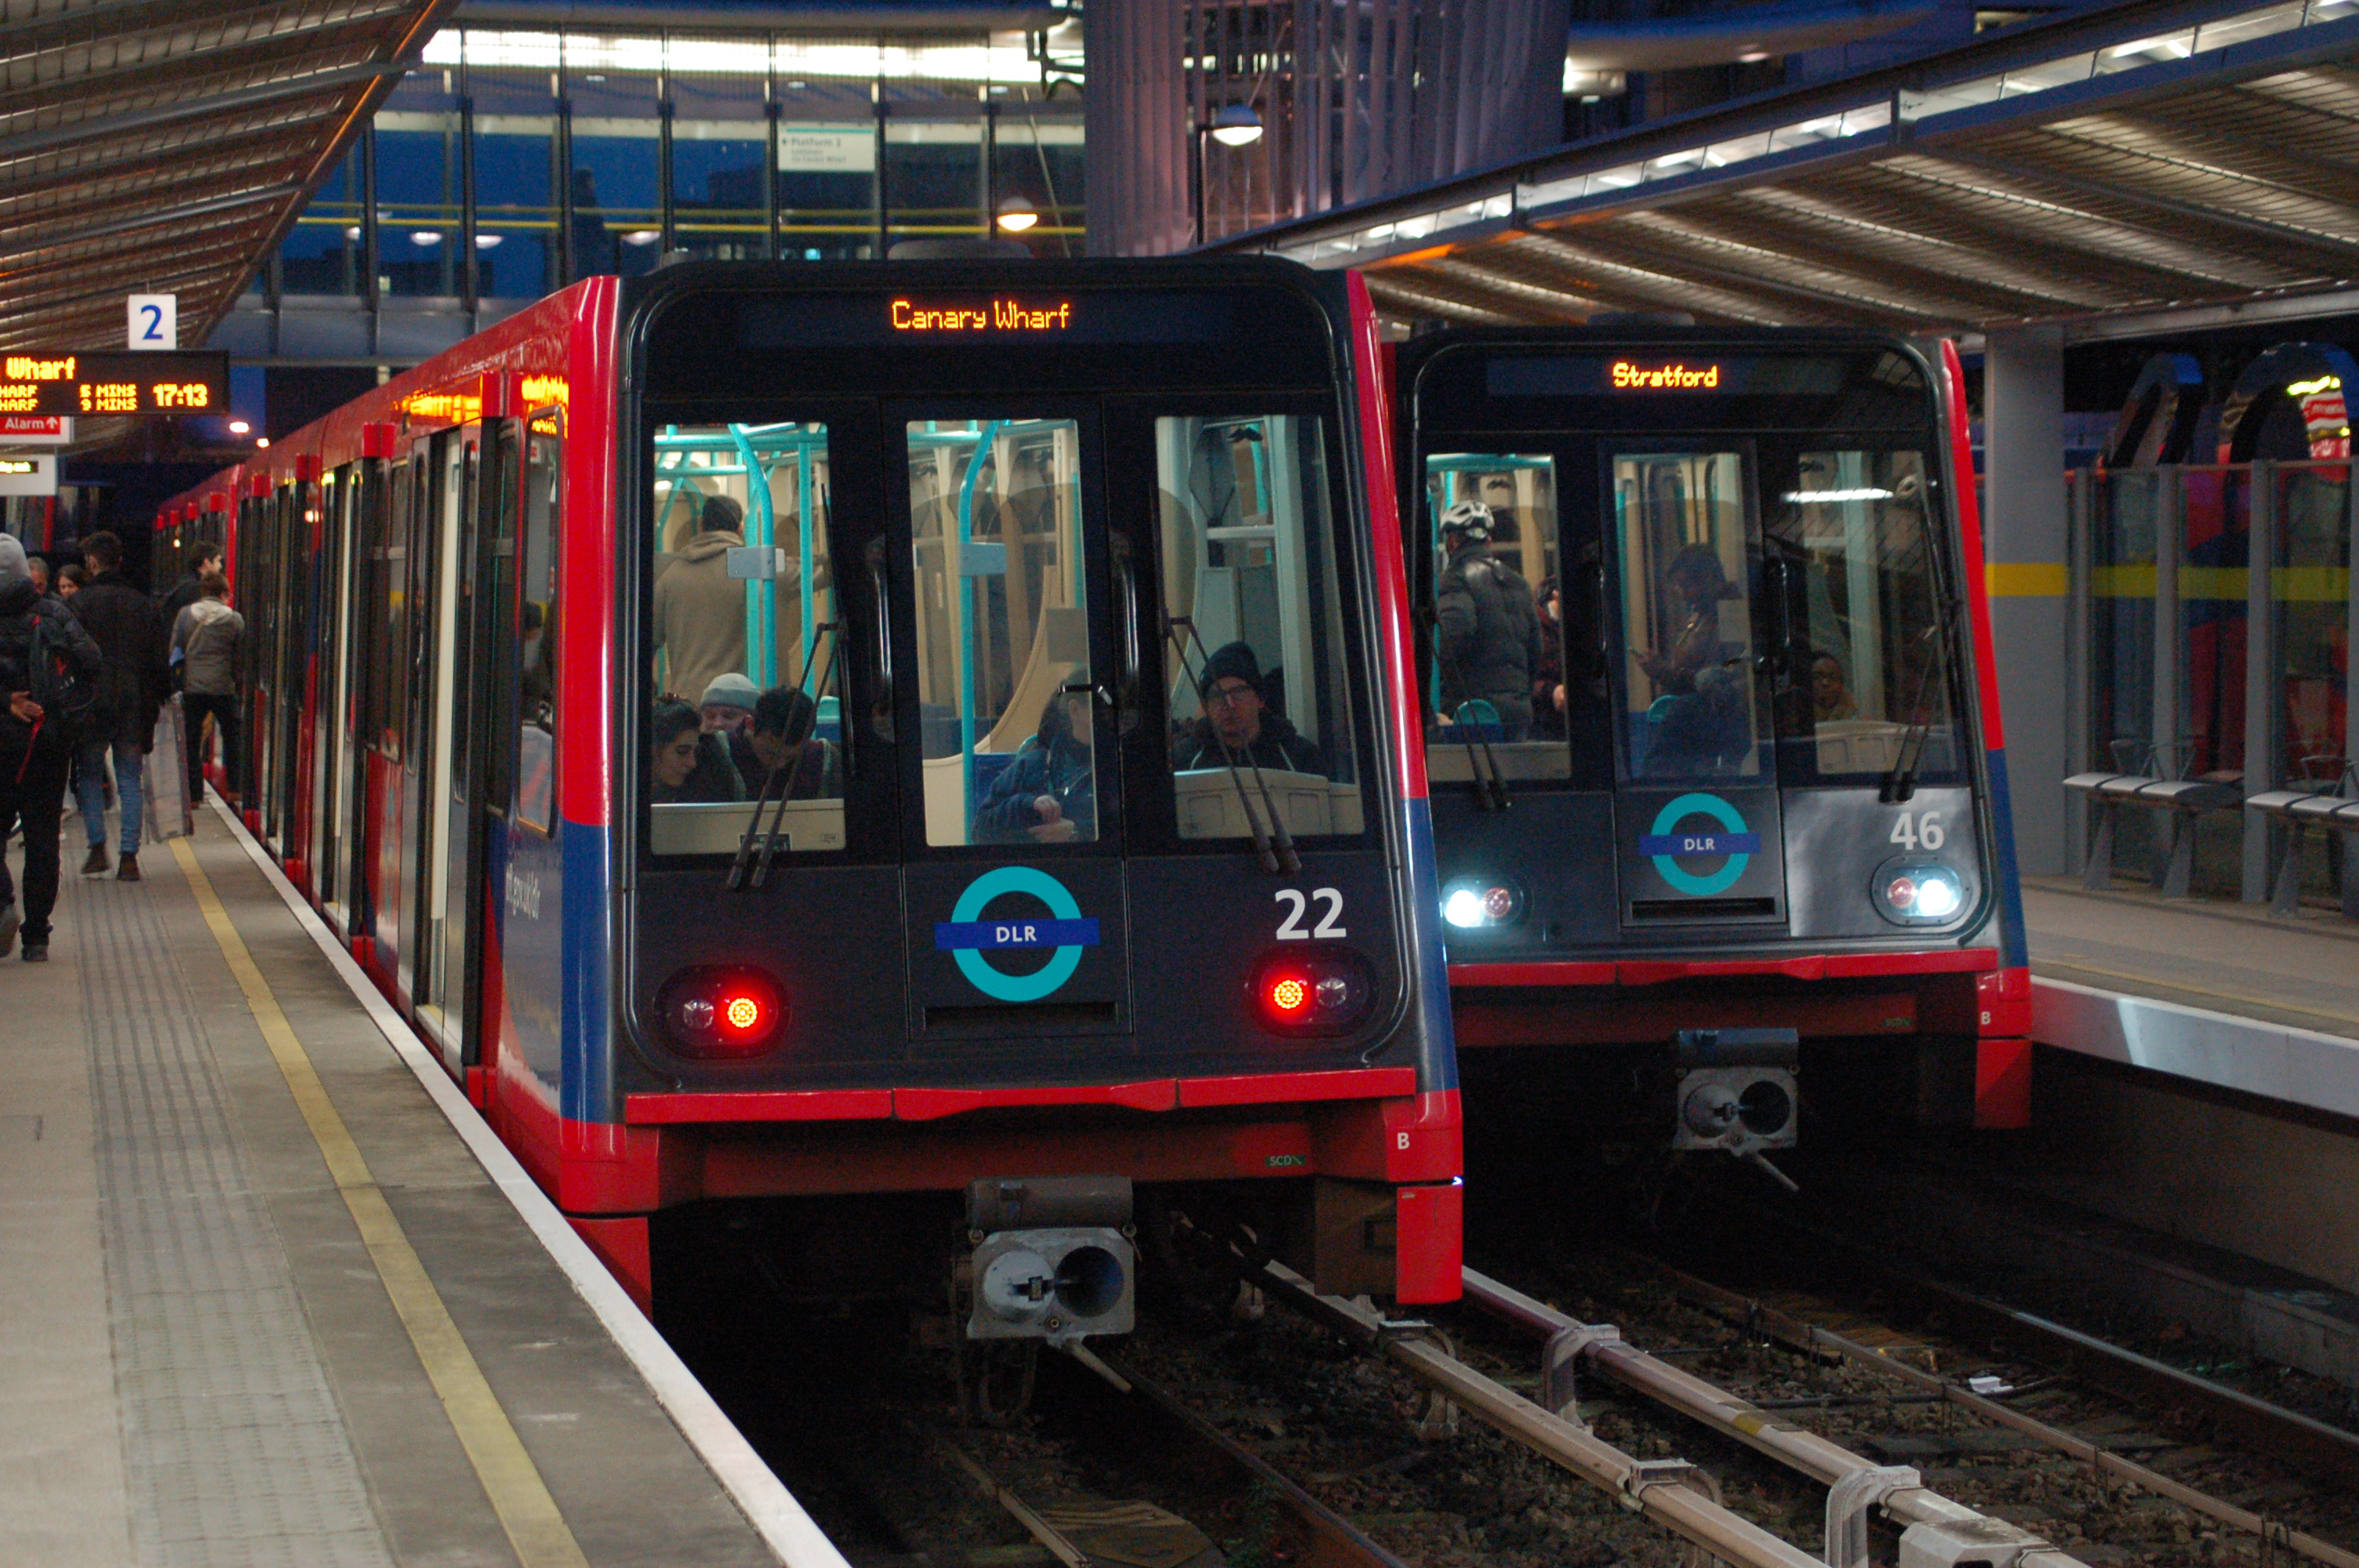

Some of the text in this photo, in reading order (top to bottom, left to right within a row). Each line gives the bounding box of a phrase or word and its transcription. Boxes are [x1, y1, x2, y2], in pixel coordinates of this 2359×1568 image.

[140, 304, 163, 340] 2
[892, 300, 1069, 329] Canary Wharf
[6, 357, 75, 380] Wharf
[1613, 362, 1717, 387] Stratford
[80, 383, 92, 397] 5
[96, 383, 136, 397] MINS
[153, 383, 208, 407] 17:13
[81, 398, 92, 412] 9
[96, 397, 137, 412] MINS
[5, 417, 45, 430] Alarm
[1890, 811, 1945, 851] 46
[1684, 837, 1716, 851] DLR
[1274, 887, 1347, 940] 22
[995, 925, 1038, 943] DLR
[1980, 1011, 1991, 1025] B
[1397, 1131, 1410, 1150] B
